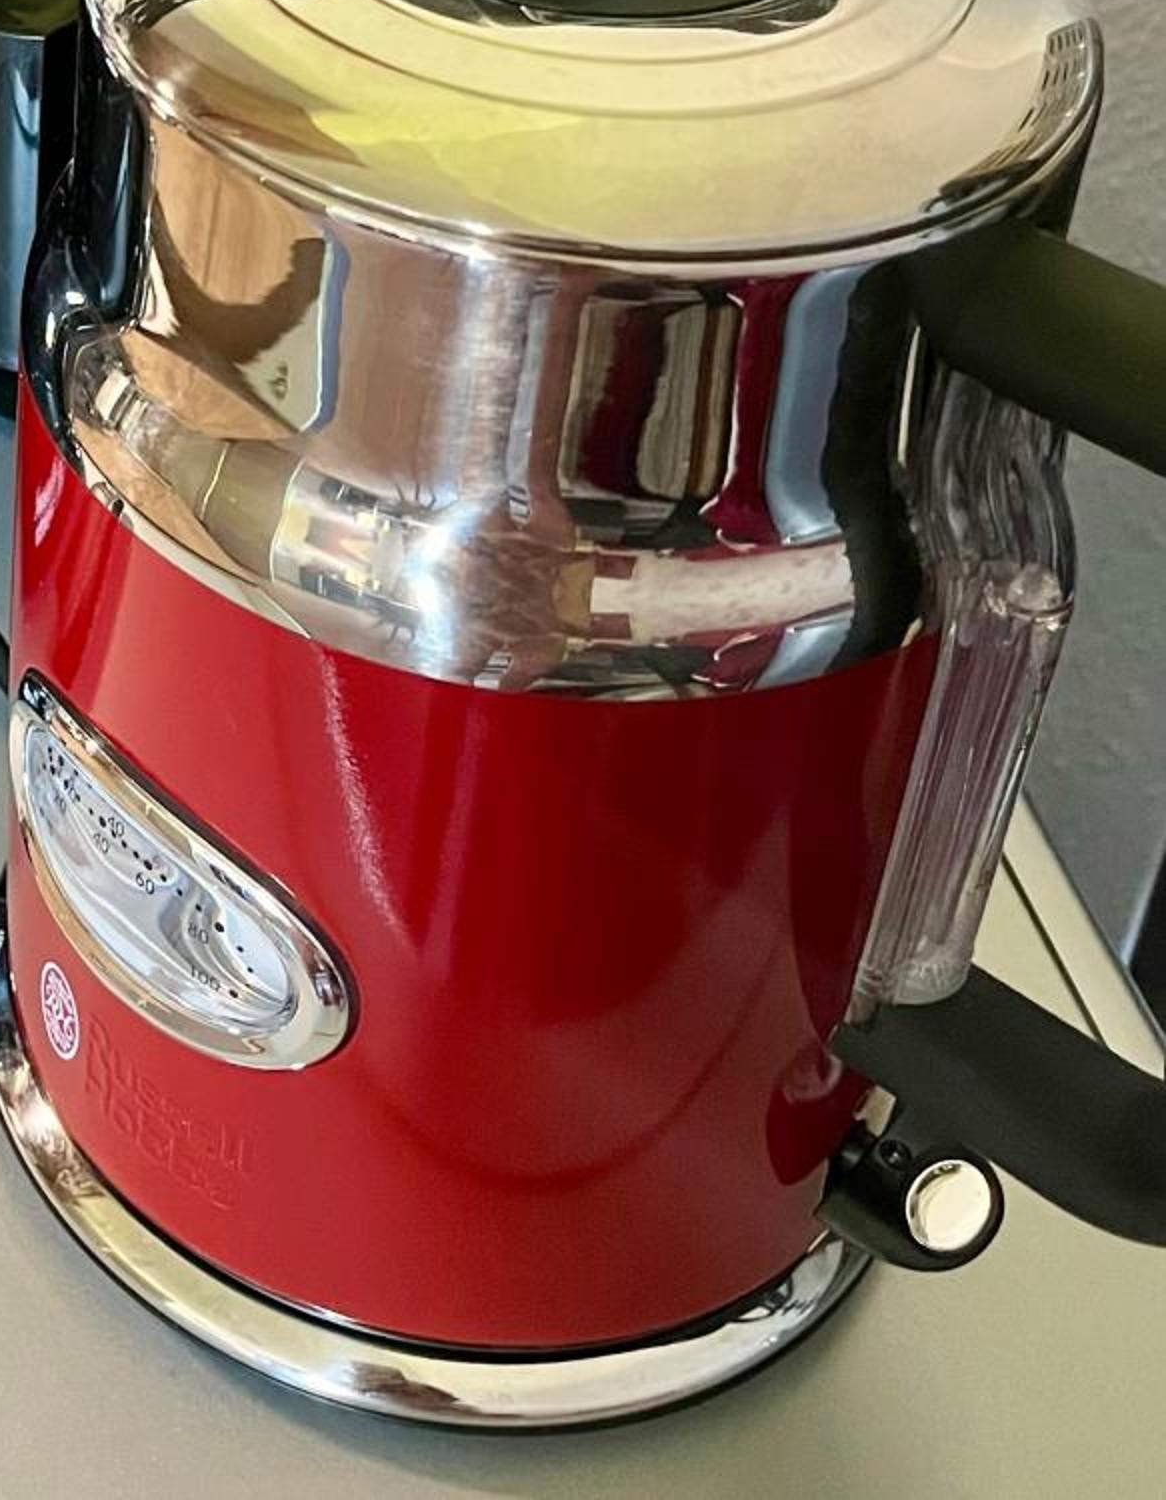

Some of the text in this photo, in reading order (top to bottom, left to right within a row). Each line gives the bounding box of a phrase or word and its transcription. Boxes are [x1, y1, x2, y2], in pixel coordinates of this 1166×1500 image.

[136, 872, 154, 895] 60
[188, 921, 209, 944] 80
[191, 964, 221, 992] 100
